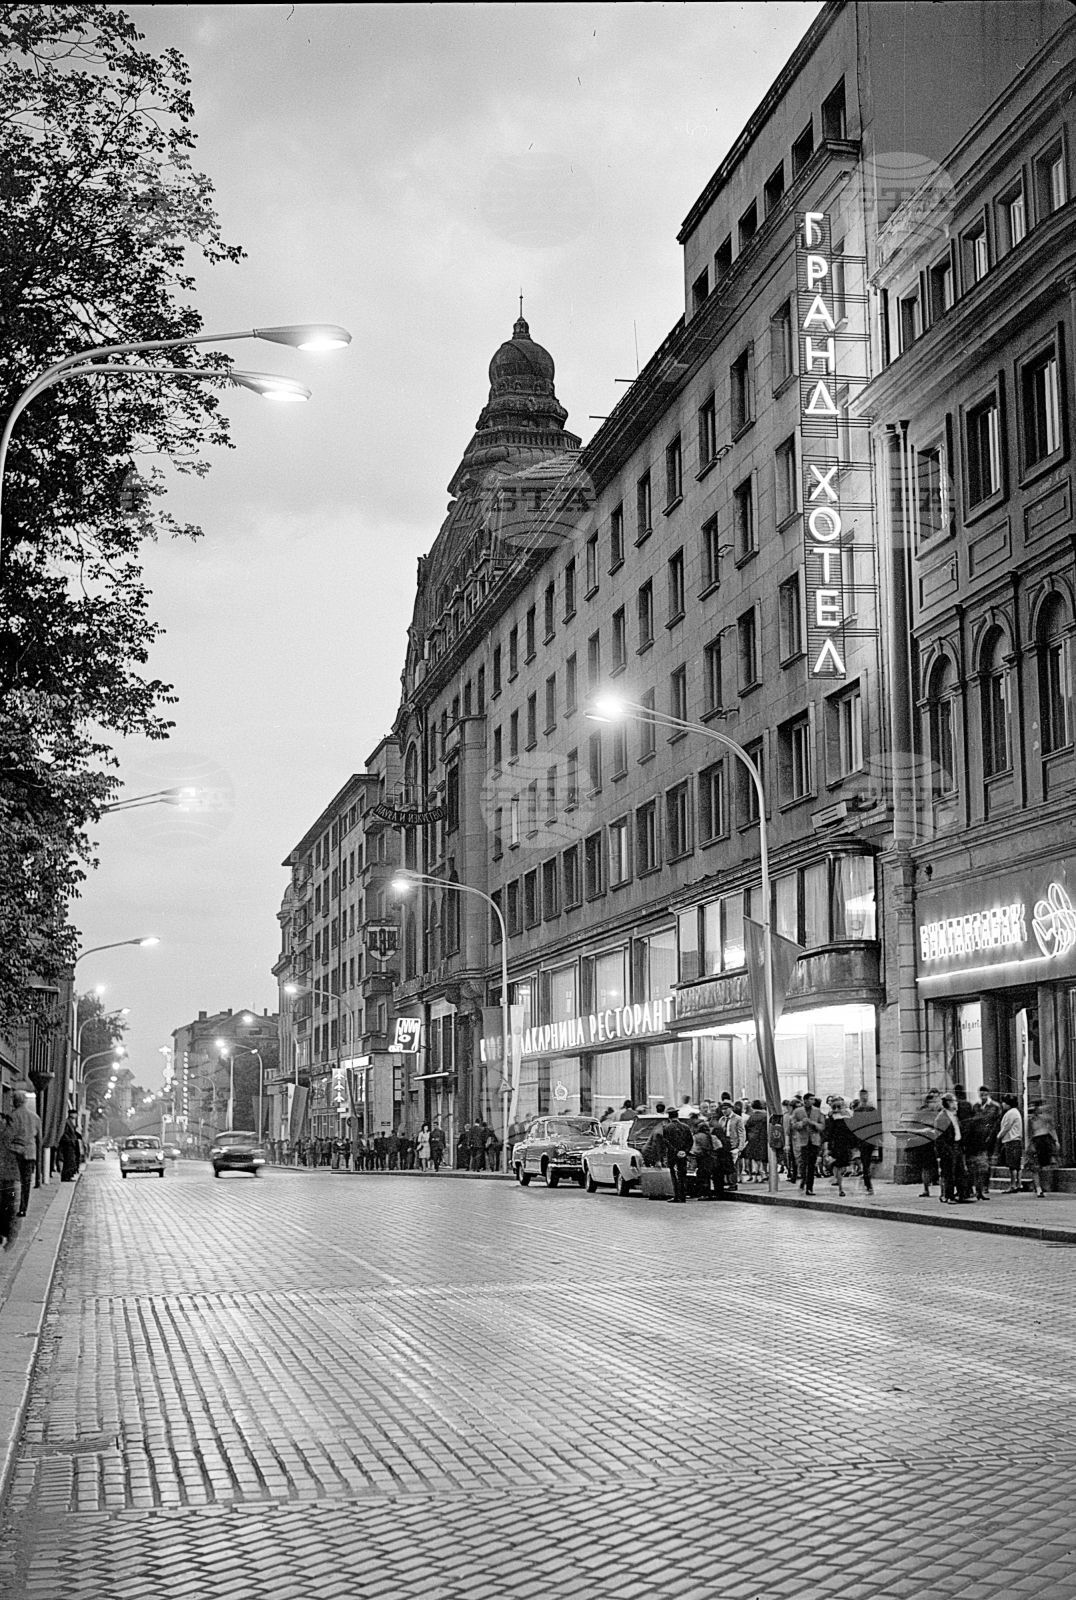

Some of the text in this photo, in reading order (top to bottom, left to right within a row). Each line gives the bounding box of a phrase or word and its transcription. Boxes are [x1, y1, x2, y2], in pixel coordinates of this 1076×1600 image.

[804, 211, 846, 676] ГРАНД ХОТЕЛ
[399, 813, 406, 823] И
[589, 996, 674, 1043] РЕСТОРАНТ
